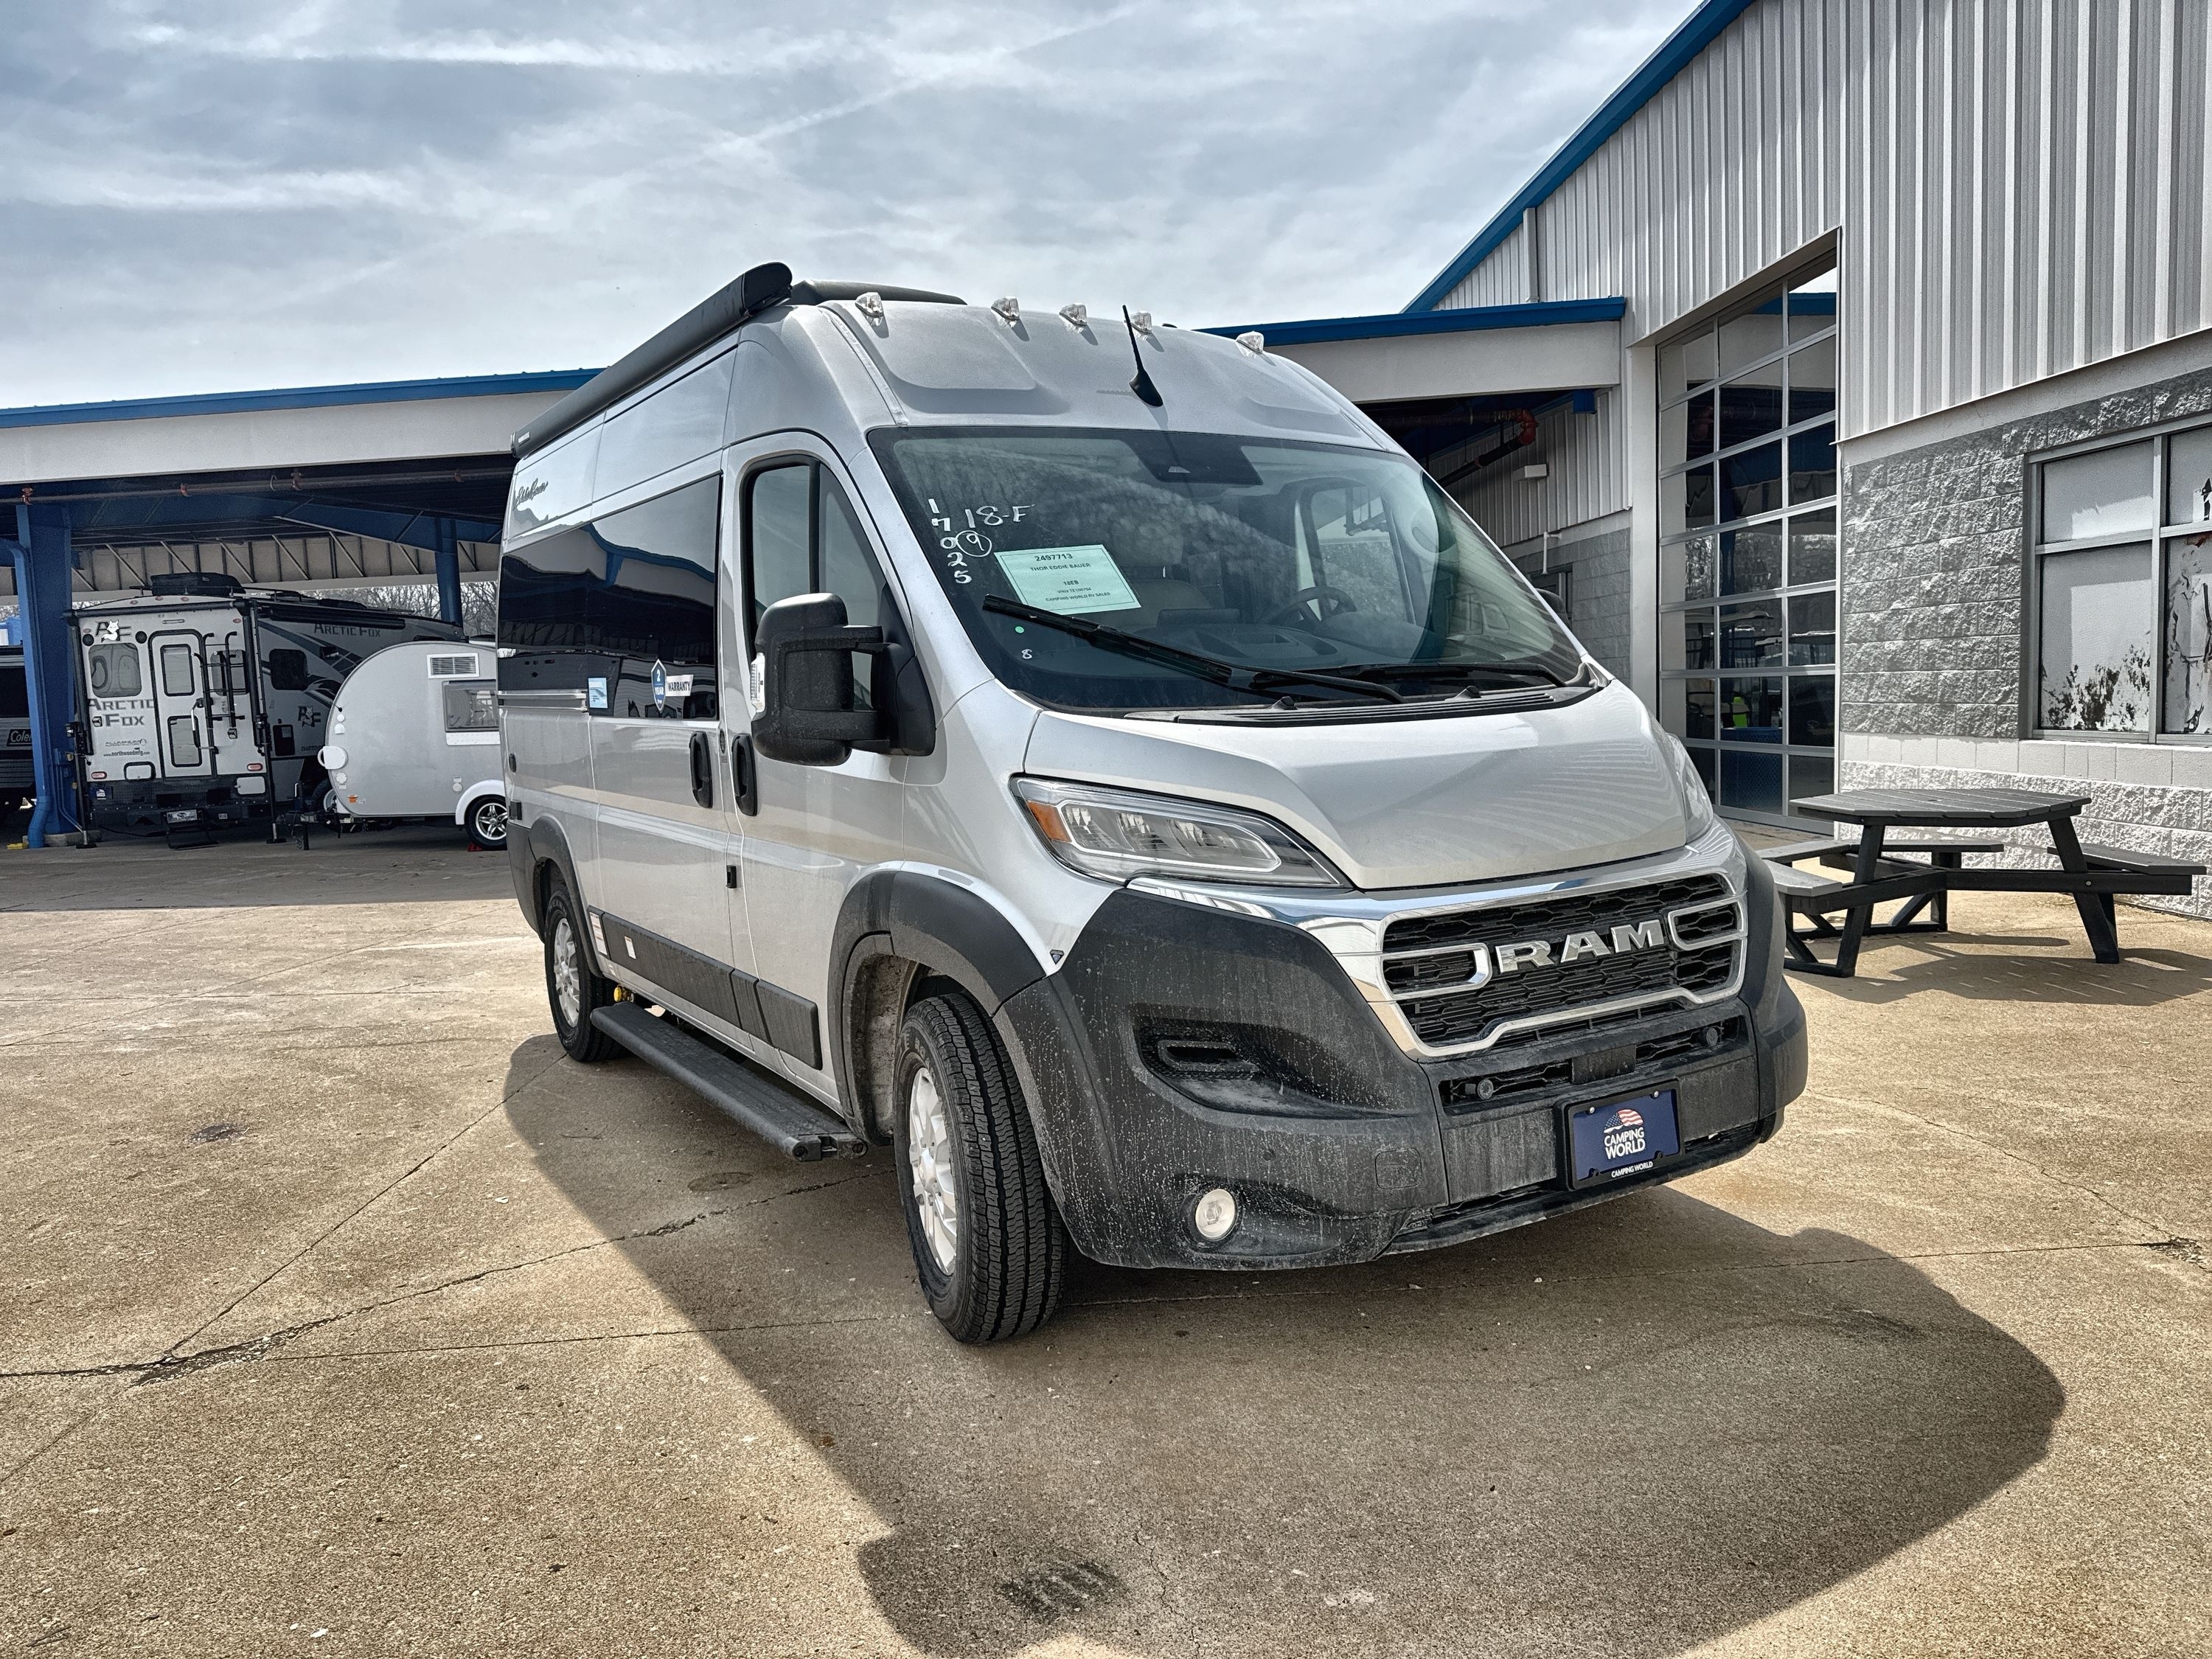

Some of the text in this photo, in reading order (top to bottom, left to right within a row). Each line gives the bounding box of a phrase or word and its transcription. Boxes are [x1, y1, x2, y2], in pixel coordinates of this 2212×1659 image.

[656, 669, 661, 682] 2
[667, 681, 691, 692] WARRANTY
[103, 713, 145, 727] FOX
[1495, 919, 1666, 974] RAM
[1604, 1127, 1644, 1147] CAMPING
[1604, 1138, 1646, 1160] WORLD
[1611, 1161, 1654, 1178] CAMPING WORLD
